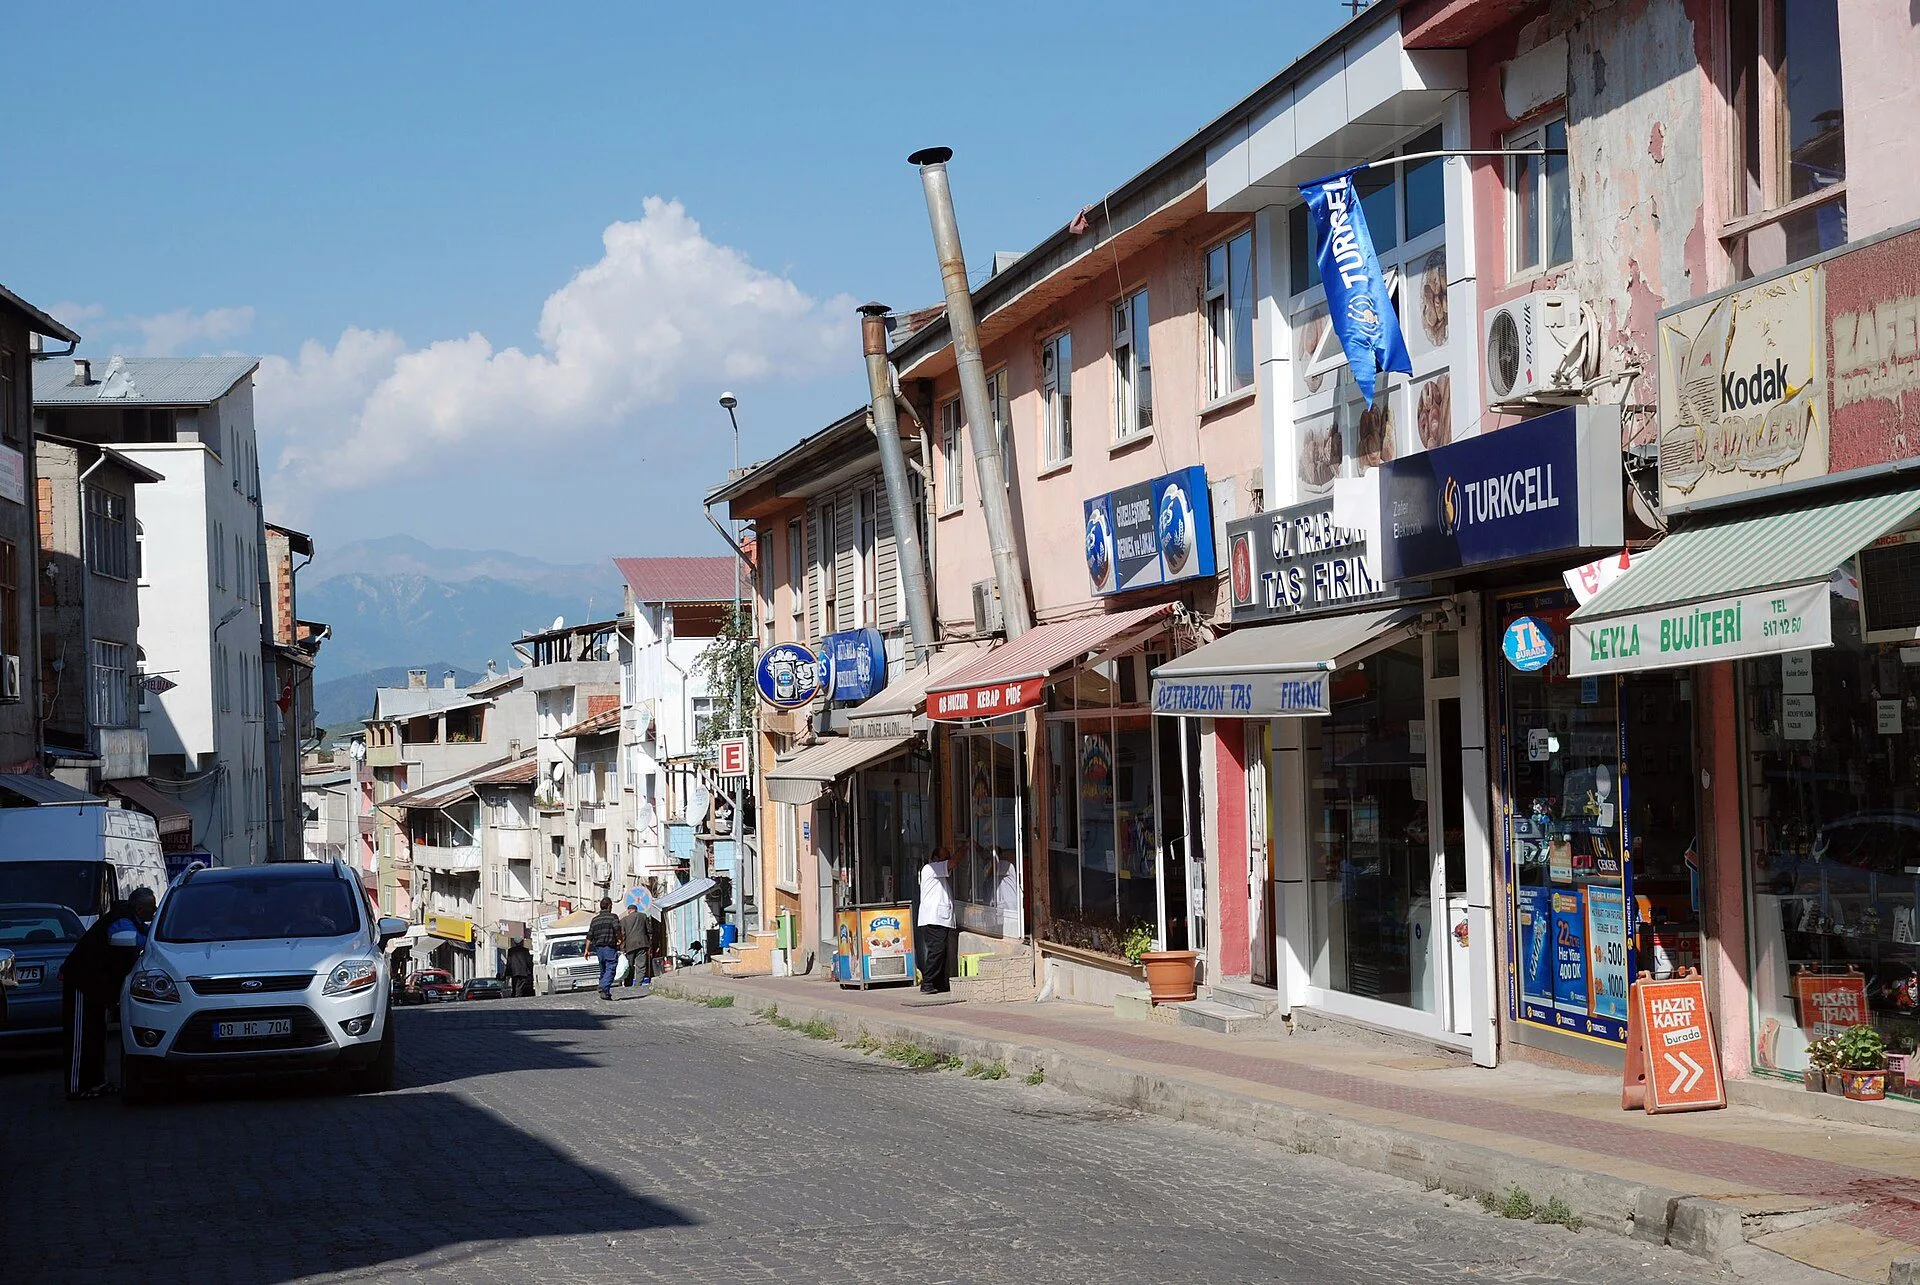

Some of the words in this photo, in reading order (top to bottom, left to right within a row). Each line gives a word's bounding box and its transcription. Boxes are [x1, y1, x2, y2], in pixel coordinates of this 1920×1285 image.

[1833, 297, 1920, 370] ZAFE
[1721, 358, 1789, 413] Kodak
[1464, 463, 1560, 525] TURKCELL
[1272, 516, 1293, 560] ÖZ
[1261, 567, 1306, 612] TAŞ
[1313, 555, 1385, 602] FIRIN
[1771, 599, 1787, 614] TEL
[1513, 621, 1546, 650] TL
[1589, 624, 1640, 661] LEYLA
[1660, 600, 1742, 652] BUJİTERİ
[1763, 620, 1777, 637] 517
[1779, 618, 1790, 635] 12
[1515, 646, 1547, 660] BURADA
[947, 692, 968, 712] HUZUR
[977, 689, 1000, 709] KEBAP
[1005, 683, 1022, 706] PİDE
[1158, 681, 1225, 710] ÖZTRABZON
[1230, 684, 1252, 714] TAŞ
[726, 746, 740, 770] E
[872, 917, 896, 928] Golf
[1557, 920, 1569, 946] 22
[1558, 946, 1568, 961] Her
[1568, 948, 1580, 962] Yöne
[1607, 941, 1622, 966] 500
[1559, 964, 1573, 980] 400
[1572, 962, 1582, 978] DK
[1608, 973, 1624, 999] 1000
[1532, 1009, 1546, 1019] TURKCELL
[1650, 997, 1696, 1014] HAZIR
[219, 1023, 234, 1036] 08
[243, 1022, 258, 1035] HC
[268, 1021, 289, 1034] 704
[1561, 1015, 1576, 1027] TURKCELL
[1592, 1022, 1607, 1034] TURKCELL
[1653, 1012, 1692, 1029] KART
[1665, 1029, 1700, 1045] burada
